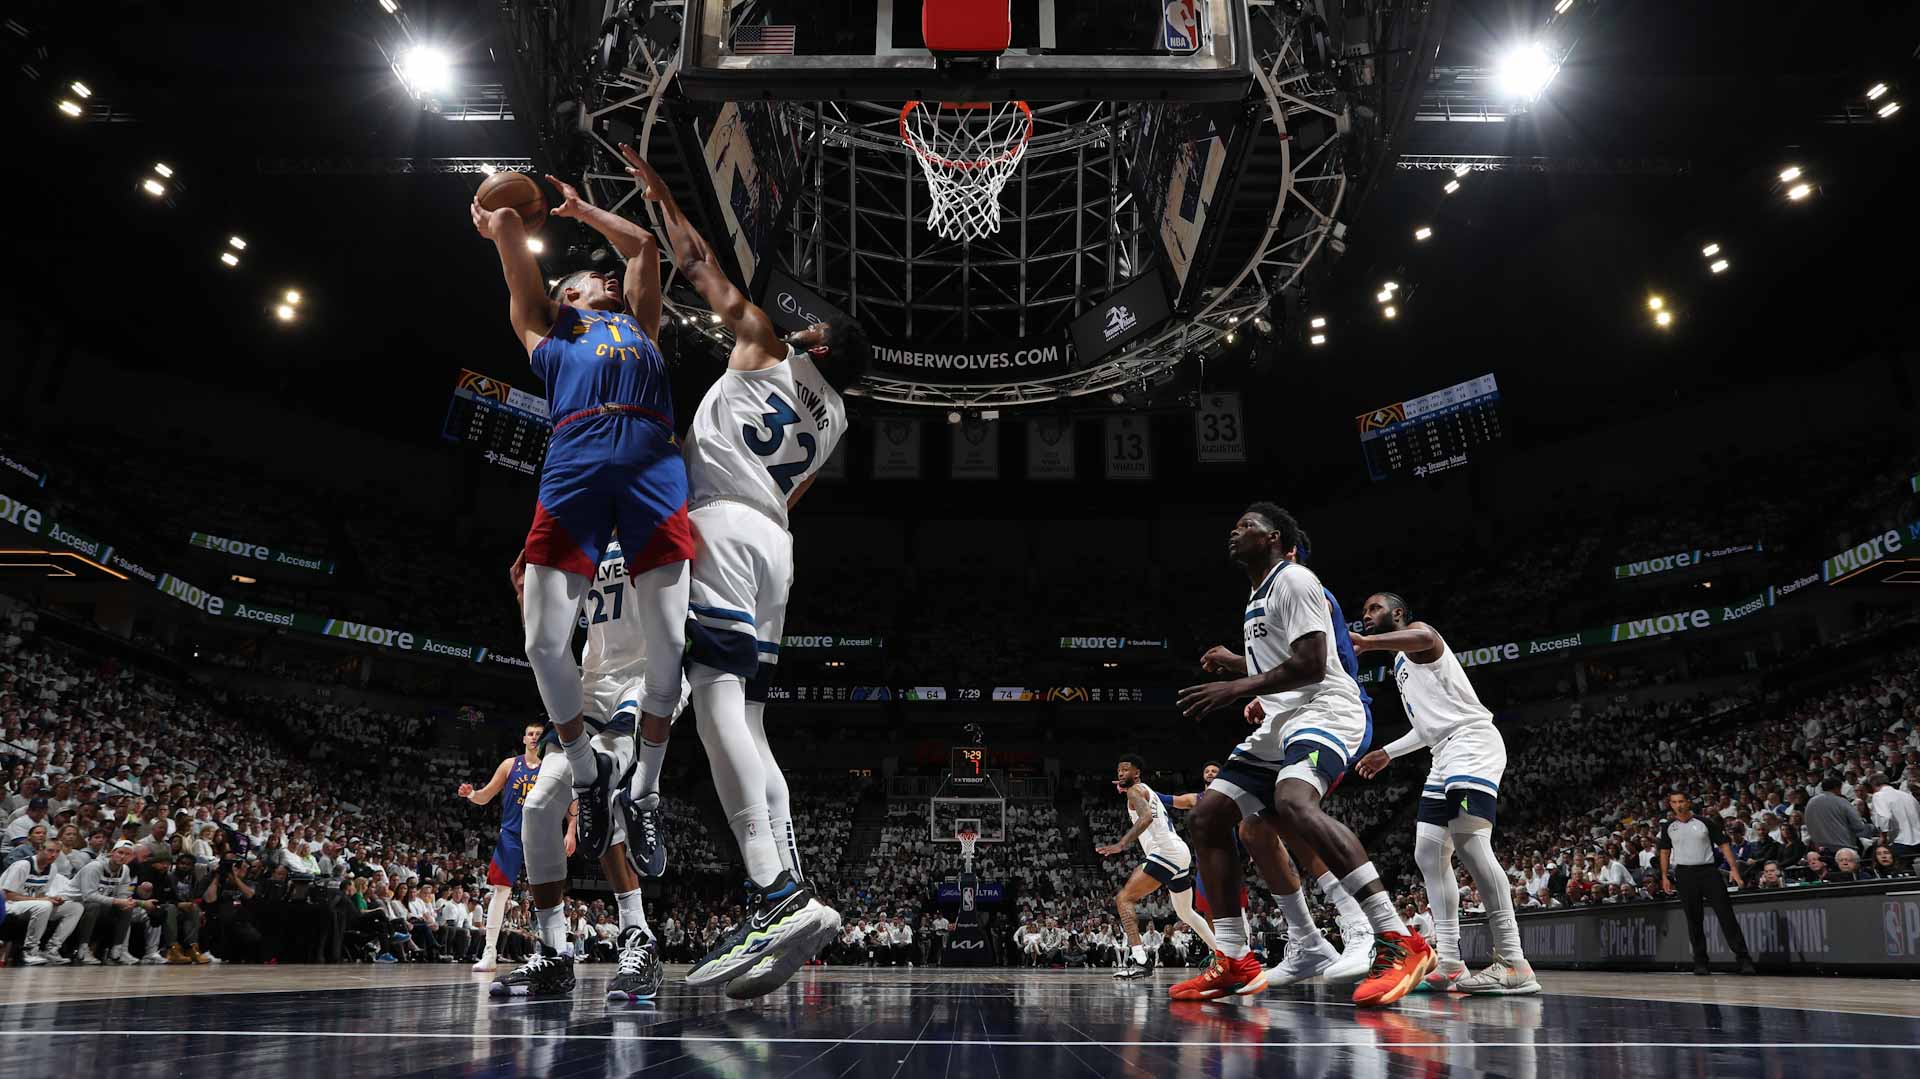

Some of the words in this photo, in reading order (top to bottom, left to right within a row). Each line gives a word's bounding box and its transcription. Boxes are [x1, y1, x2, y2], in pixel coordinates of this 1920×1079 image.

[1170, 37, 1186, 47] NBA
[608, 323, 621, 343] 1
[595, 343, 640, 361] CITY
[871, 344, 1058, 369] TIMBERWOLVES.COM
[795, 380, 829, 431] TOWNS
[1203, 413, 1237, 441] 33
[742, 392, 816, 495] 32
[1113, 434, 1143, 460] 13
[48, 523, 99, 557] Access!
[207, 533, 270, 560] More
[276, 552, 321, 569] Access!
[1833, 529, 1903, 576] More
[1628, 552, 1690, 576] More
[167, 575, 224, 615] More
[234, 604, 295, 626] Access!
[588, 582, 624, 624] 27
[1628, 609, 1710, 639] More
[1722, 594, 1765, 622] Access!
[340, 621, 414, 649] More
[422, 639, 472, 658] Access!
[785, 634, 833, 648] More
[838, 638, 873, 647] Access!
[1071, 637, 1117, 649] More
[1529, 634, 1582, 655] Access!
[926, 691, 938, 699] 64
[958, 688, 980, 699] 7:29
[1000, 691, 1012, 699] 74
[963, 750, 981, 760] 7:29
[969, 759, 980, 775] 7
[1554, 923, 1575, 956] WIN!
[1609, 918, 1656, 956] Pick'Em
[1786, 908, 1829, 953] WIN!
